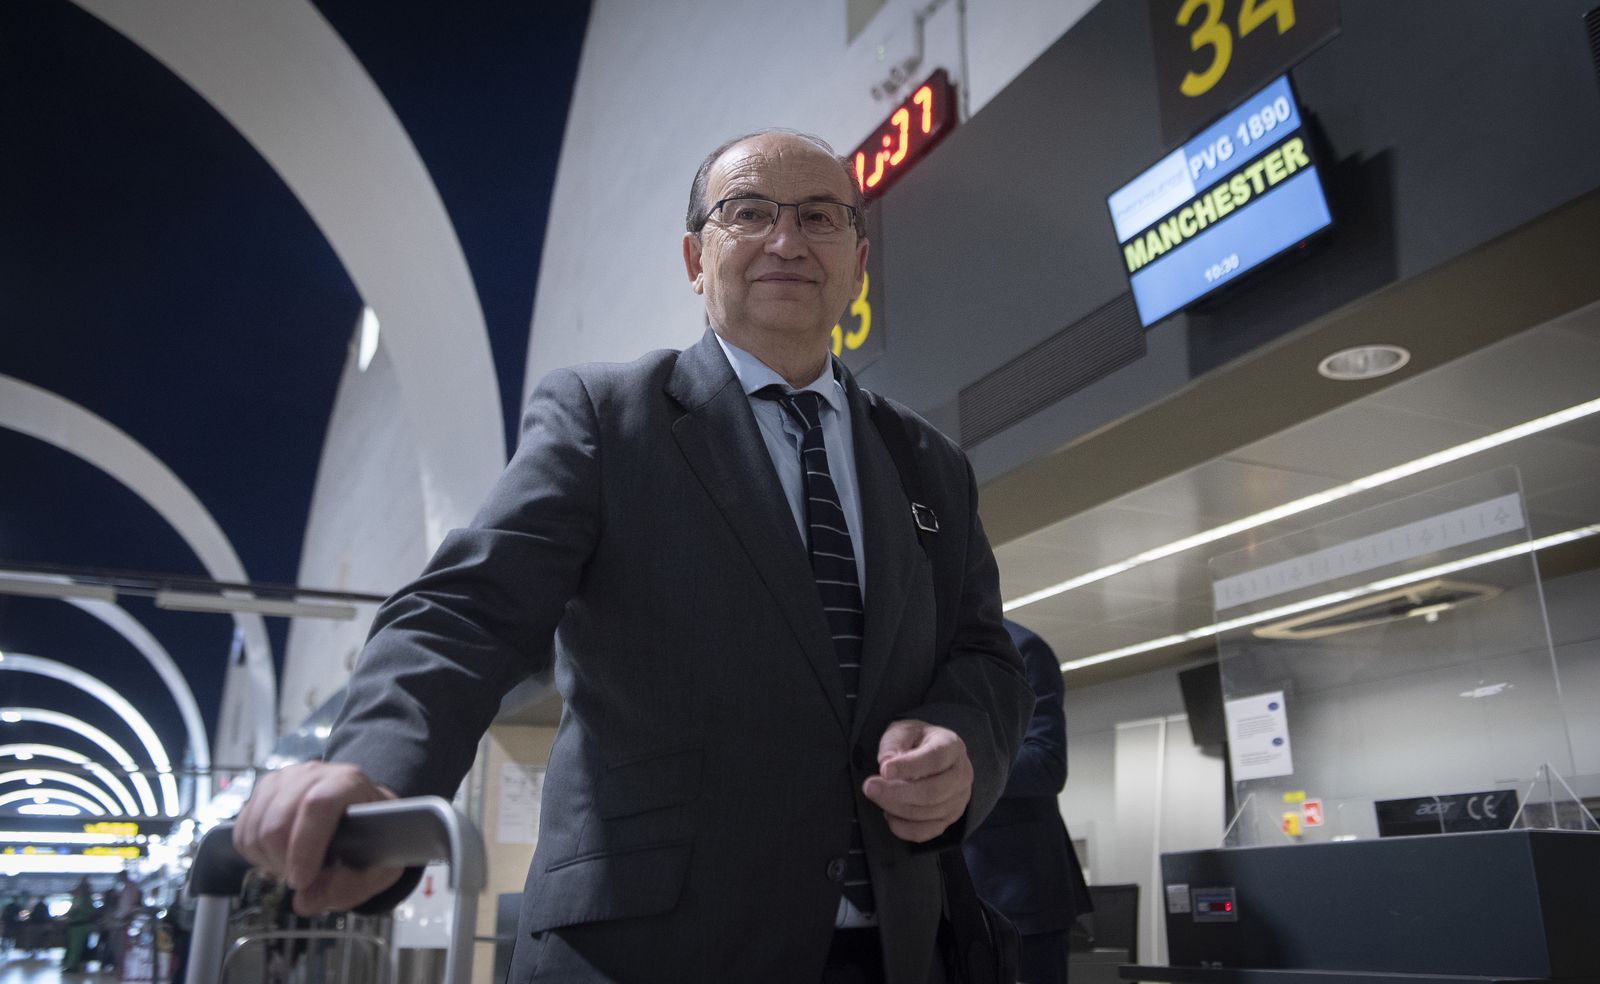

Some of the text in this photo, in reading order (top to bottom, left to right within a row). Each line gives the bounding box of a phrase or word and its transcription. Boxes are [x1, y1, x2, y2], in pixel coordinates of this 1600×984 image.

[1188, 96, 1291, 181] PVG 1890
[1123, 136, 1309, 273] MANCHESTER
